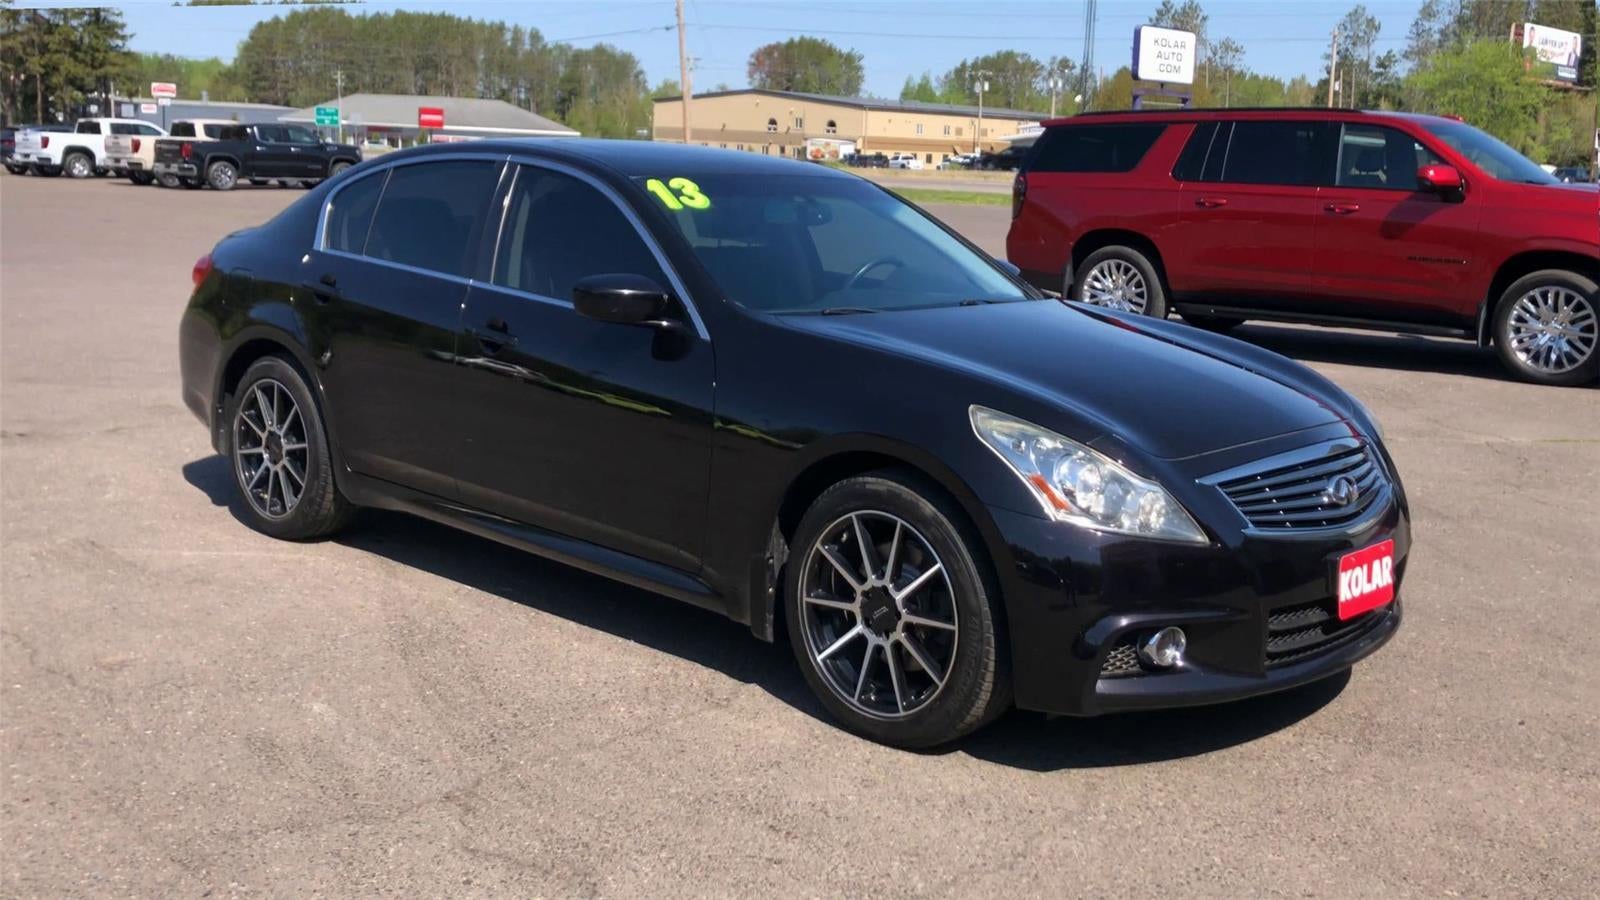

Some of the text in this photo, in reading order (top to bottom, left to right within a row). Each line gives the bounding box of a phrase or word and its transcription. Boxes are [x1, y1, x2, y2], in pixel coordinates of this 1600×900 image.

[1153, 38, 1186, 49] KOLAR
[1156, 50, 1183, 62] AUTO
[646, 177, 710, 210] 13
[1339, 555, 1393, 602] KOLAR
